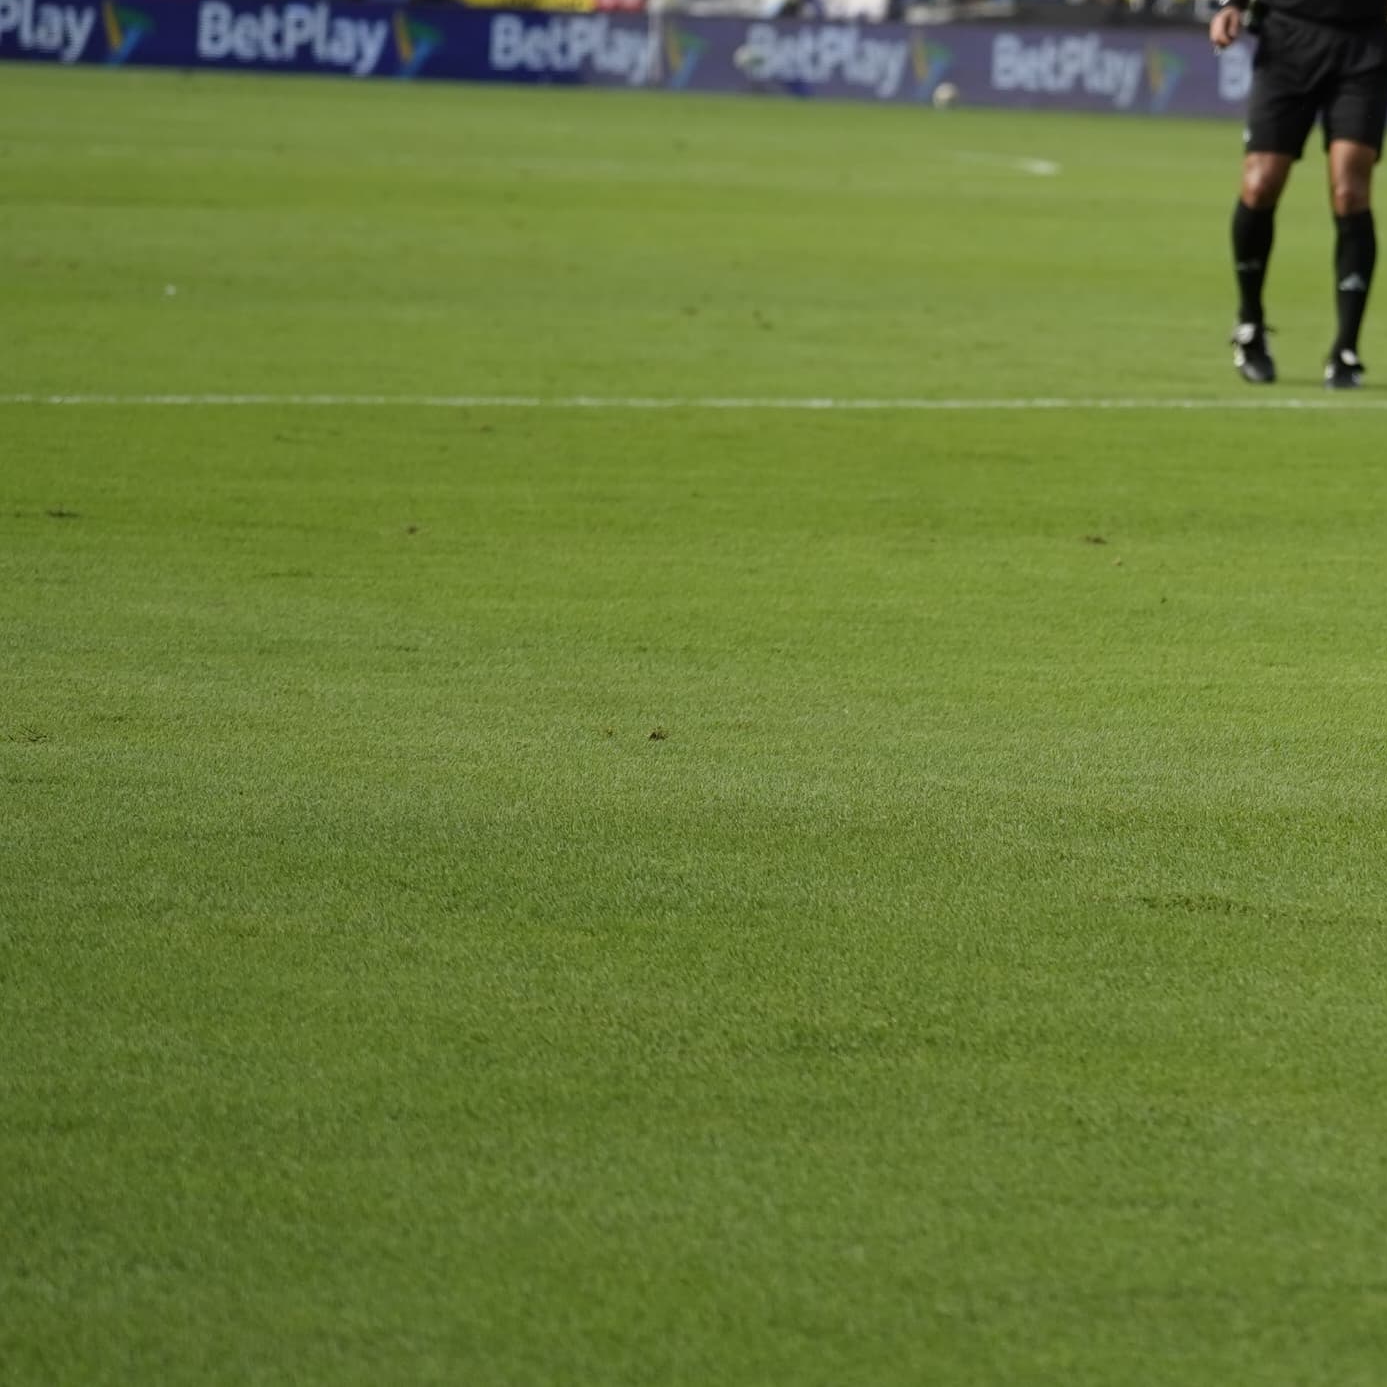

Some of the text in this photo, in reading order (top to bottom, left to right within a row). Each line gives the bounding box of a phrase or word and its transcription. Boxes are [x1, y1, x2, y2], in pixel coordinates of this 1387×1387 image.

[488, 13, 660, 87] BetPlay
[747, 23, 908, 99] BetPlay
[990, 31, 1145, 108] BetPlay
